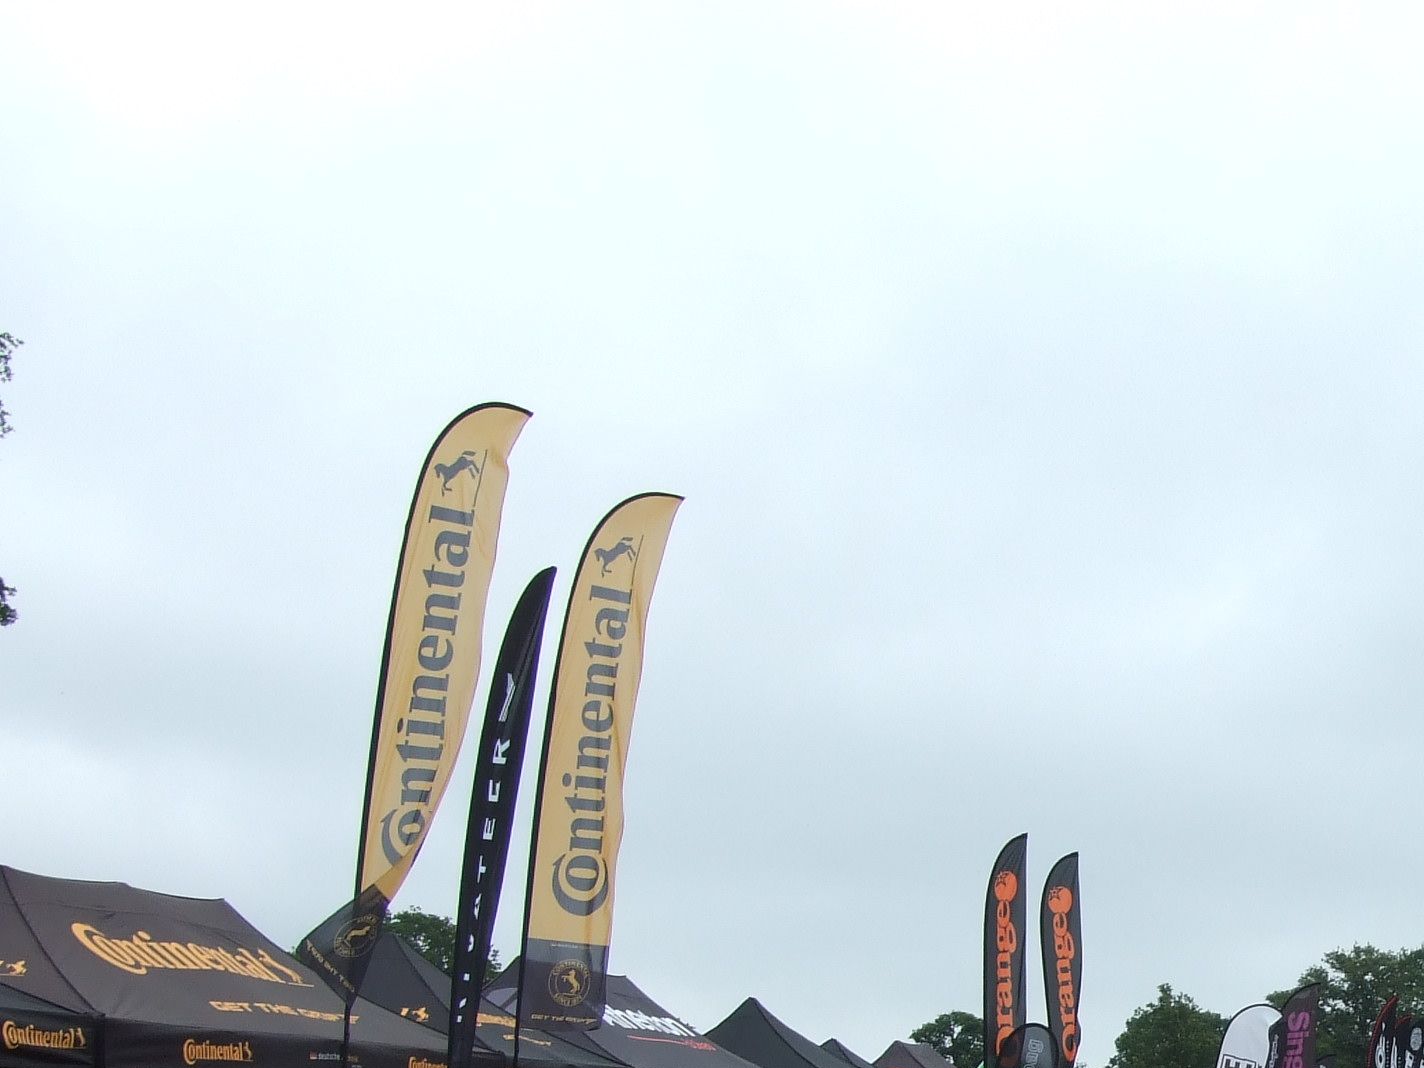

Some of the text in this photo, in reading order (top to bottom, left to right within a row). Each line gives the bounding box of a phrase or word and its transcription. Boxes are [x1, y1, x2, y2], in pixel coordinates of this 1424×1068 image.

[381, 504, 475, 867] Continental
[552, 585, 633, 917] Continental
[71, 922, 287, 985] Continental
[2, 1019, 74, 1049] Continental
[183, 1038, 244, 1066] Continental
